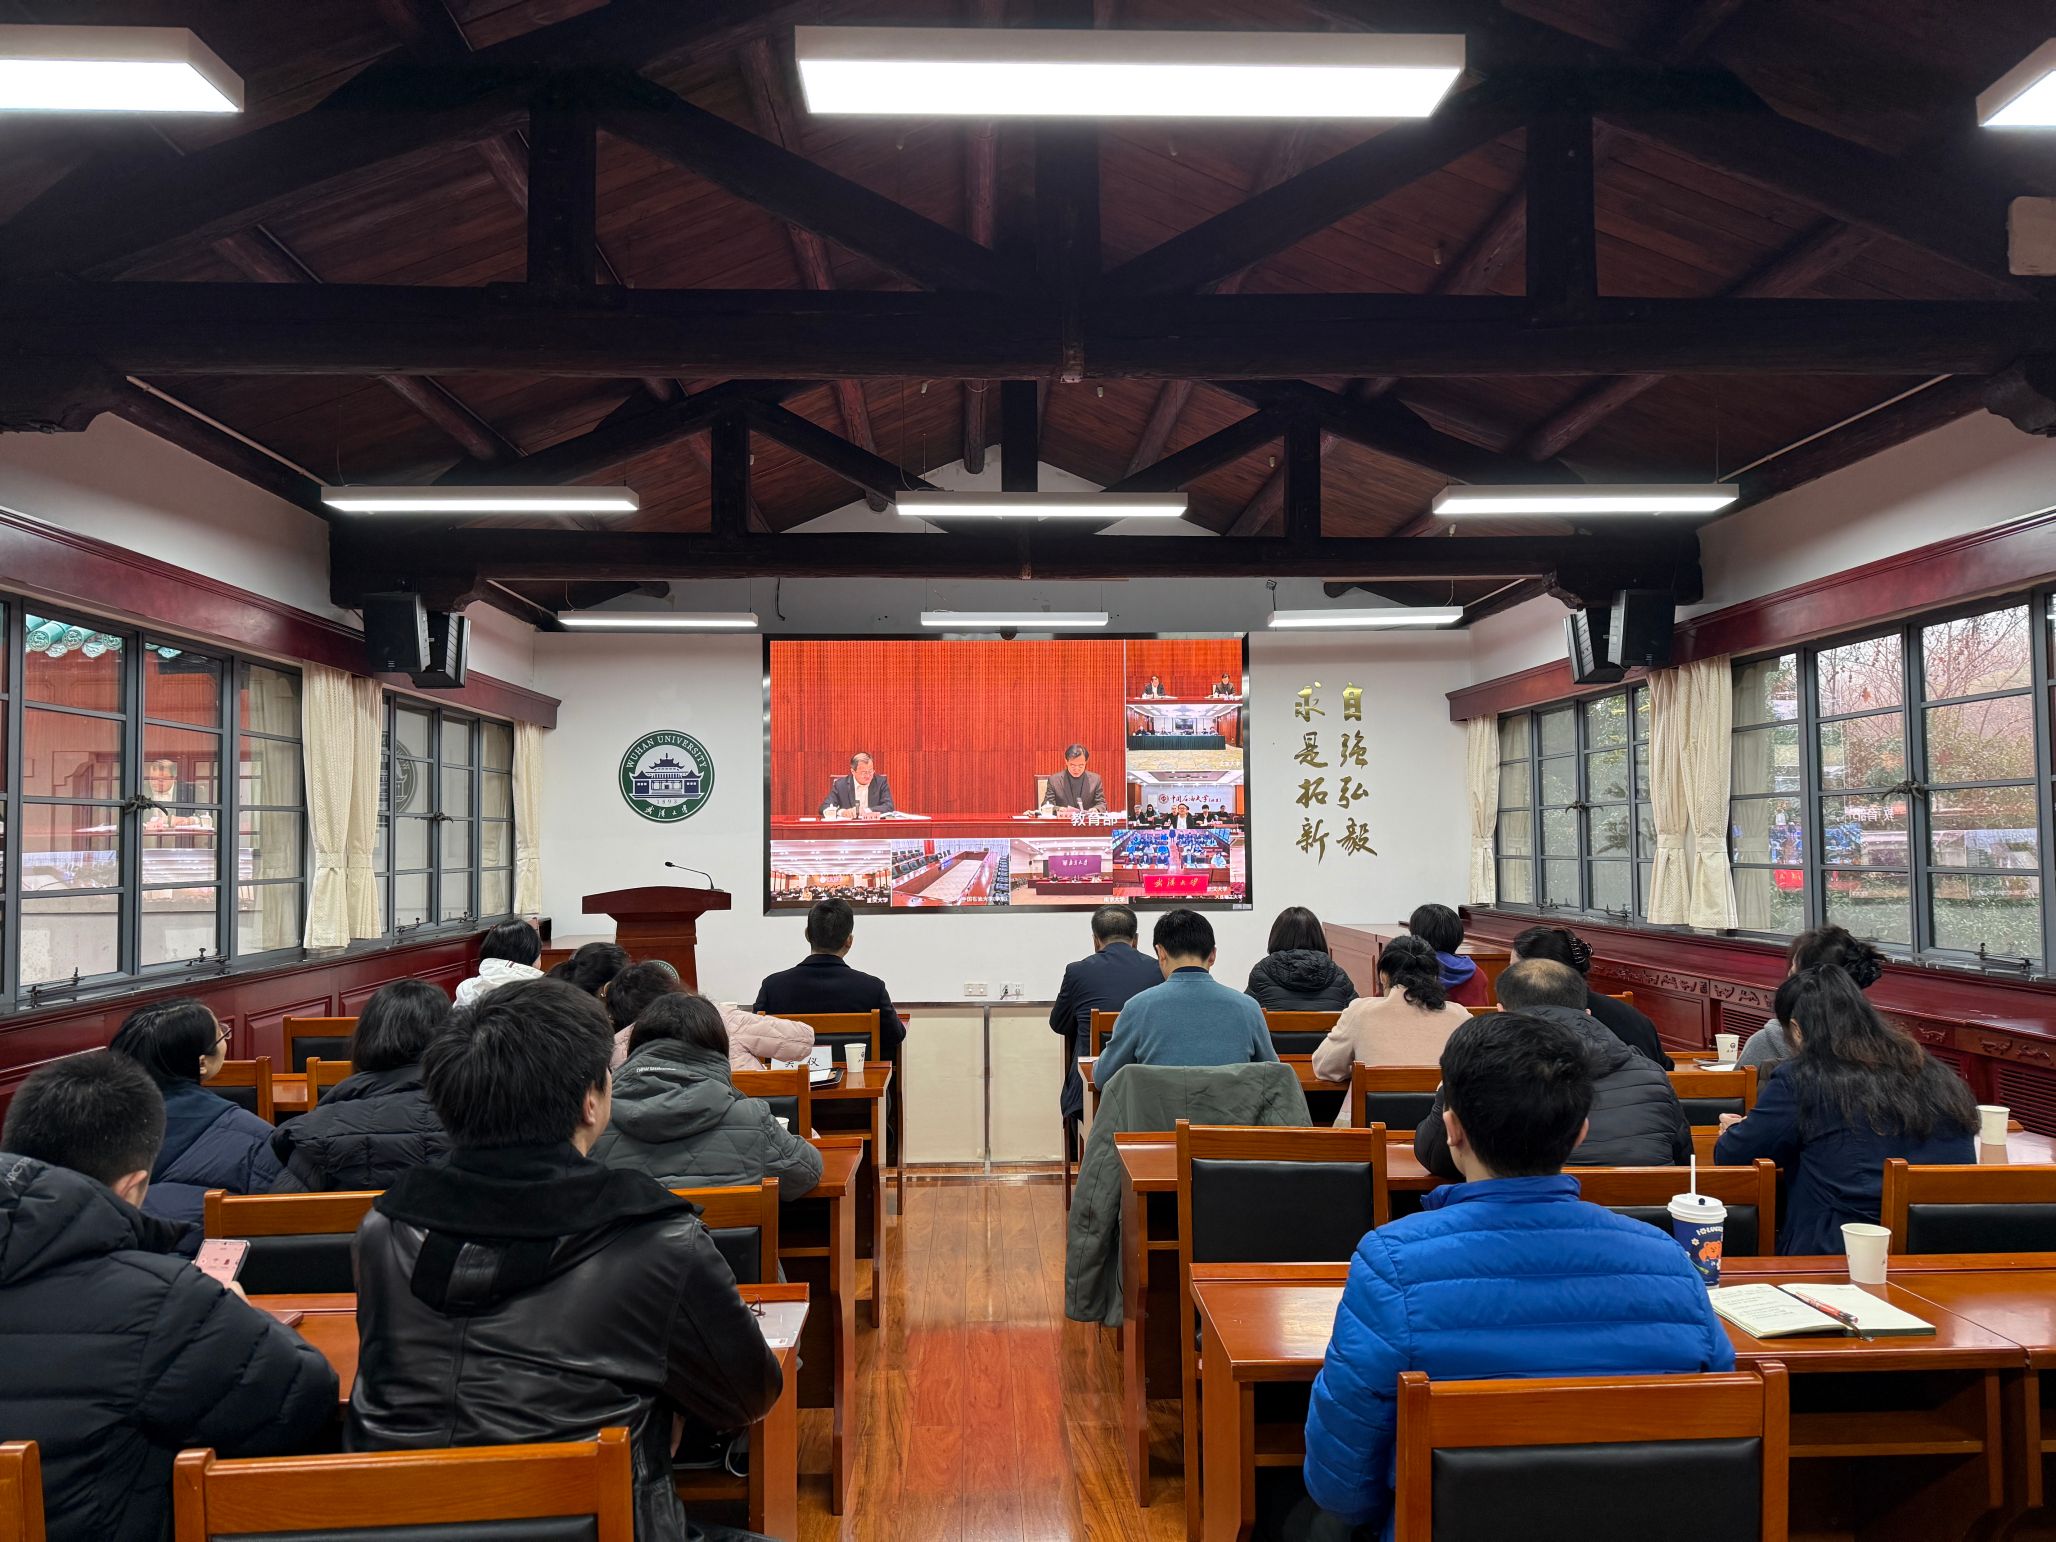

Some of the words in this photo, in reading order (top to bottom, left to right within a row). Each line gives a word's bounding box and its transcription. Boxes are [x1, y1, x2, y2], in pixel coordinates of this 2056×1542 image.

[626, 738, 655, 768] WUHAN
[656, 735, 708, 768] UNIVERSITY
[1293, 680, 1330, 866] 求是拓新
[1071, 812, 1118, 827] 教育部
